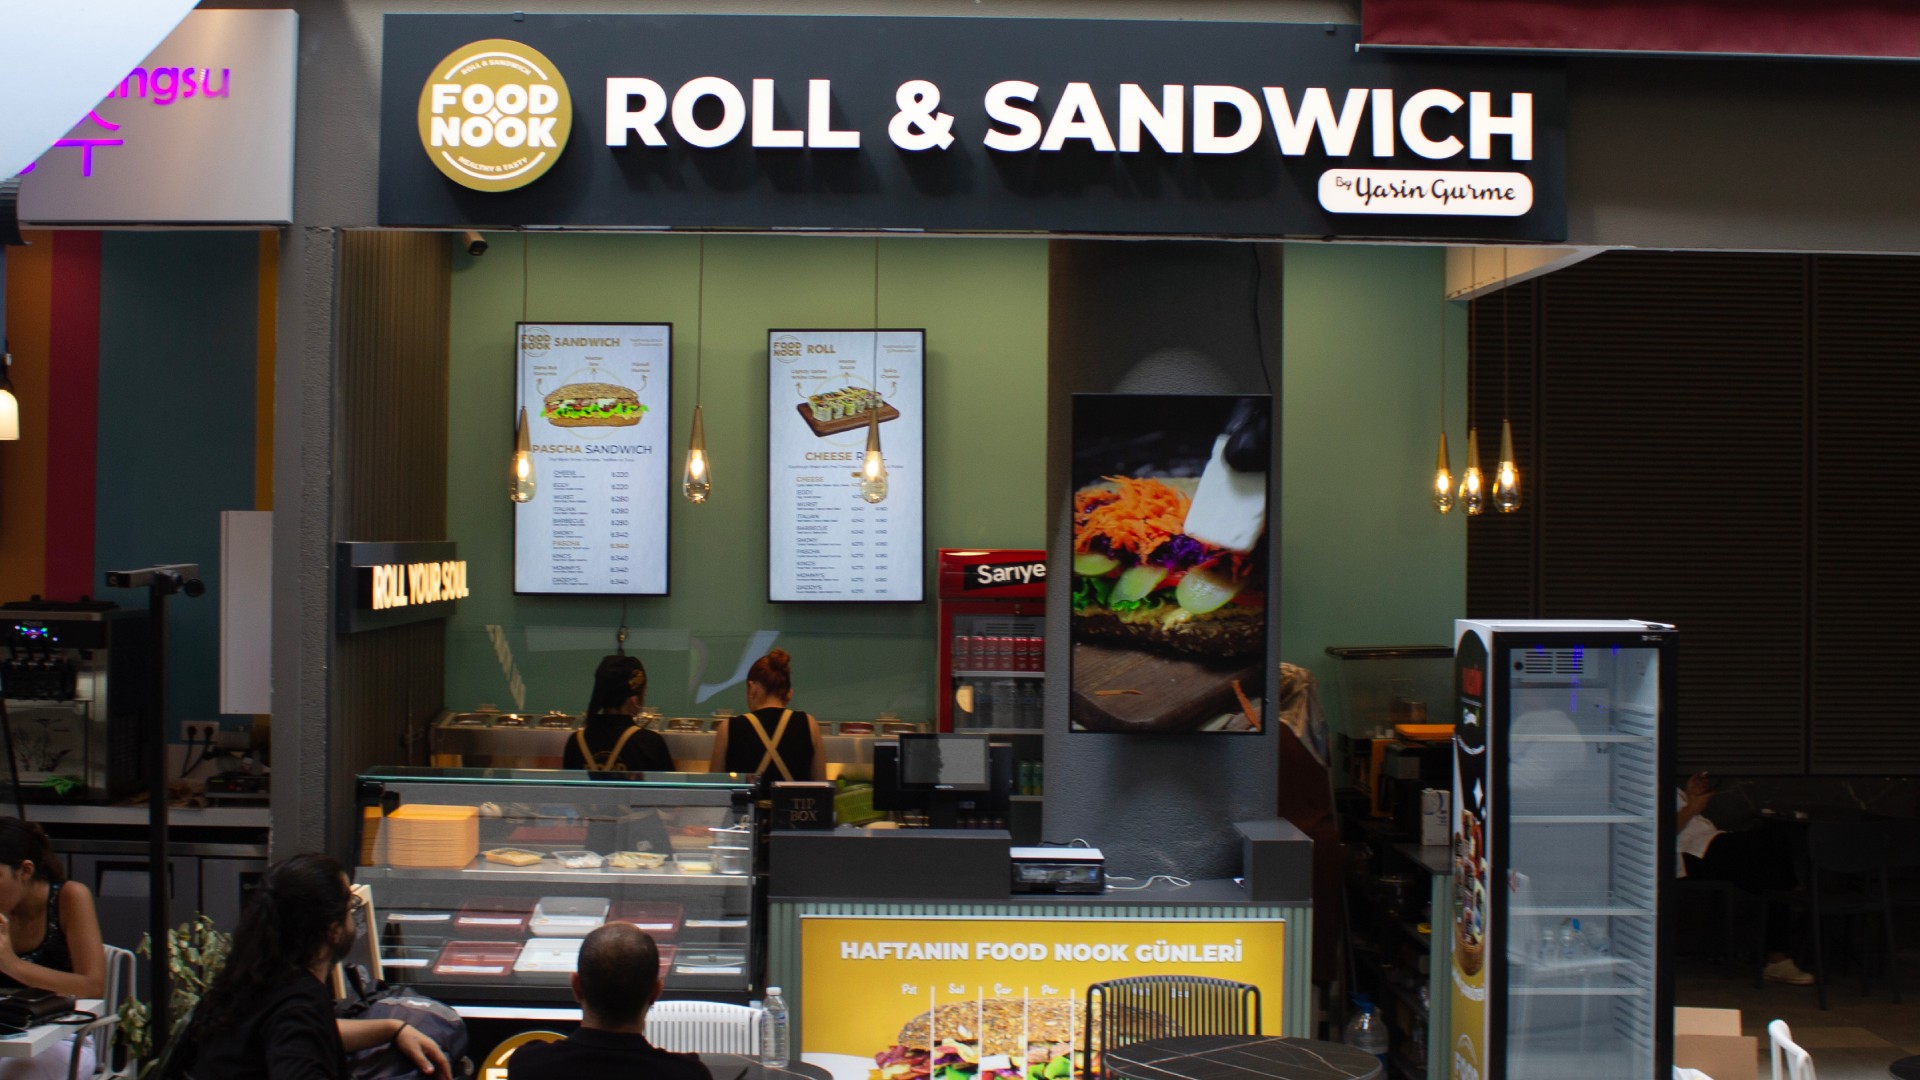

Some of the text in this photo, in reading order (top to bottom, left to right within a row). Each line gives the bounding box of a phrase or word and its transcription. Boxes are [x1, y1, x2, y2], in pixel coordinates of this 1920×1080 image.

[106, 66, 230, 105] ngsu
[431, 83, 559, 115] FOOD
[605, 76, 1533, 161] ROLL & SANDWICH
[430, 116, 558, 148] NOOK
[1336, 176, 1516, 206] By Yasin Gurme
[554, 337, 621, 347] SANDWICH
[807, 344, 837, 354] ROLL
[532, 444, 653, 454] PASCHA SANDWICH
[805, 452, 853, 461] CHEESE
[372, 560, 470, 610] ROLL YOUR SOUL
[977, 563, 1047, 584] Sarıye
[790, 810, 818, 821] BOX
[792, 798, 816, 810] TIP
[841, 938, 1244, 963] HAFTANIN FOOD NOOK GÜNLERİ
